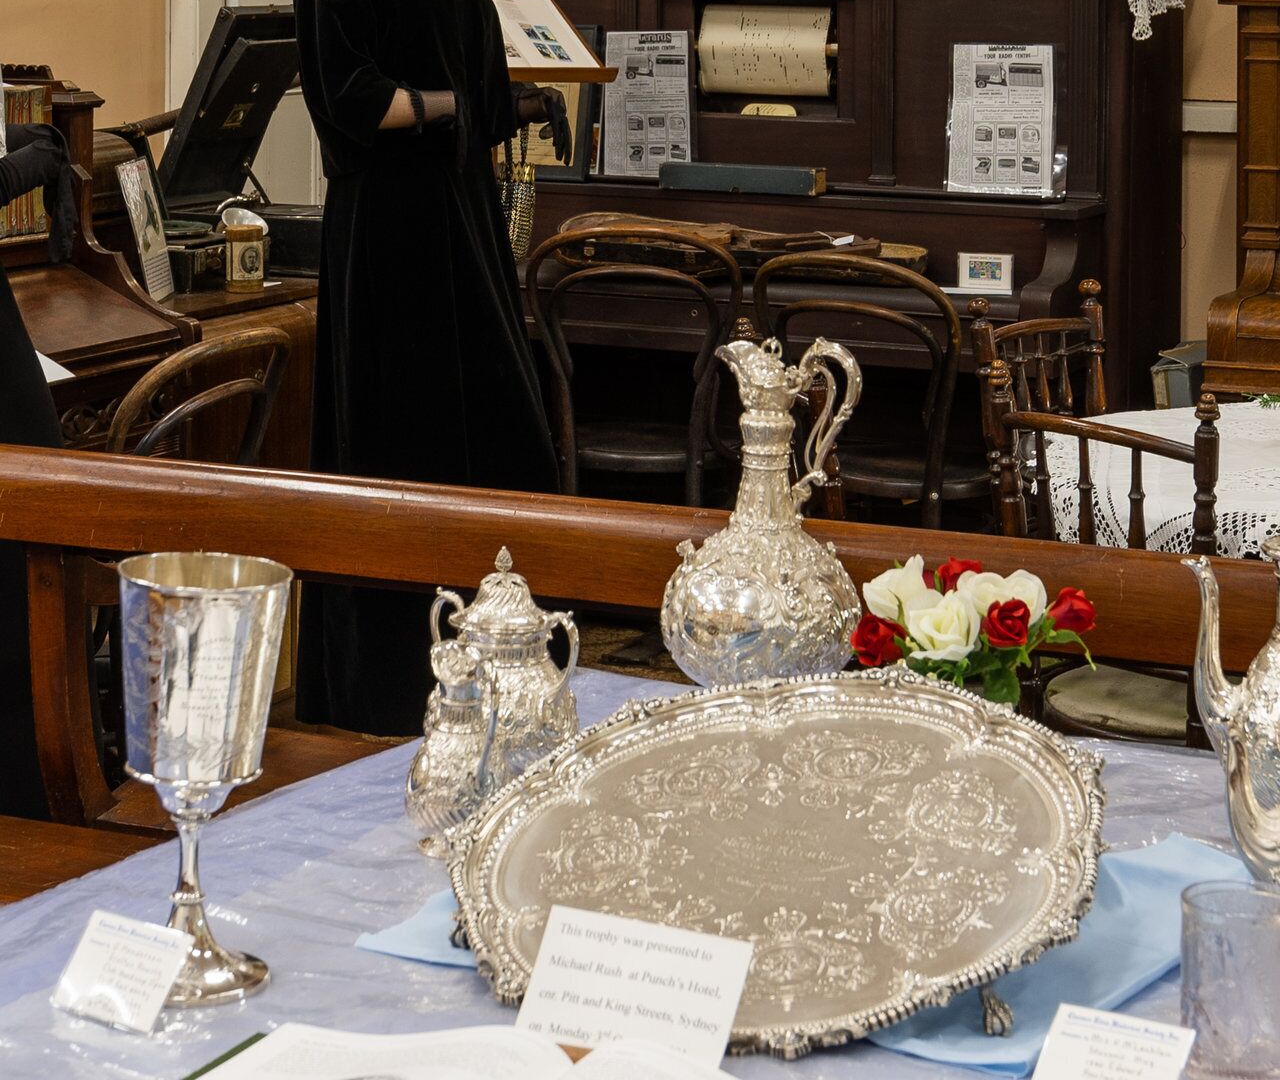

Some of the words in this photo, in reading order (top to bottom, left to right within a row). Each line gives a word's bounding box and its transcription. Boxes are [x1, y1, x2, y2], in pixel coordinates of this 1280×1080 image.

[560, 922, 583, 936] This
[585, 929, 619, 946] trophy
[623, 937, 644, 948] was
[645, 941, 699, 960] presented
[701, 949, 713, 961] to
[549, 955, 593, 972] Michael
[595, 963, 622, 977] Rush
[628, 970, 639, 981] at
[561, 992, 581, 1006] Pitt
[582, 997, 603, 1009] and
[605, 999, 632, 1016] King
[679, 1014, 720, 1034] Sydney
[528, 1022, 542, 1032] on
[547, 1023, 591, 1042] Monday
